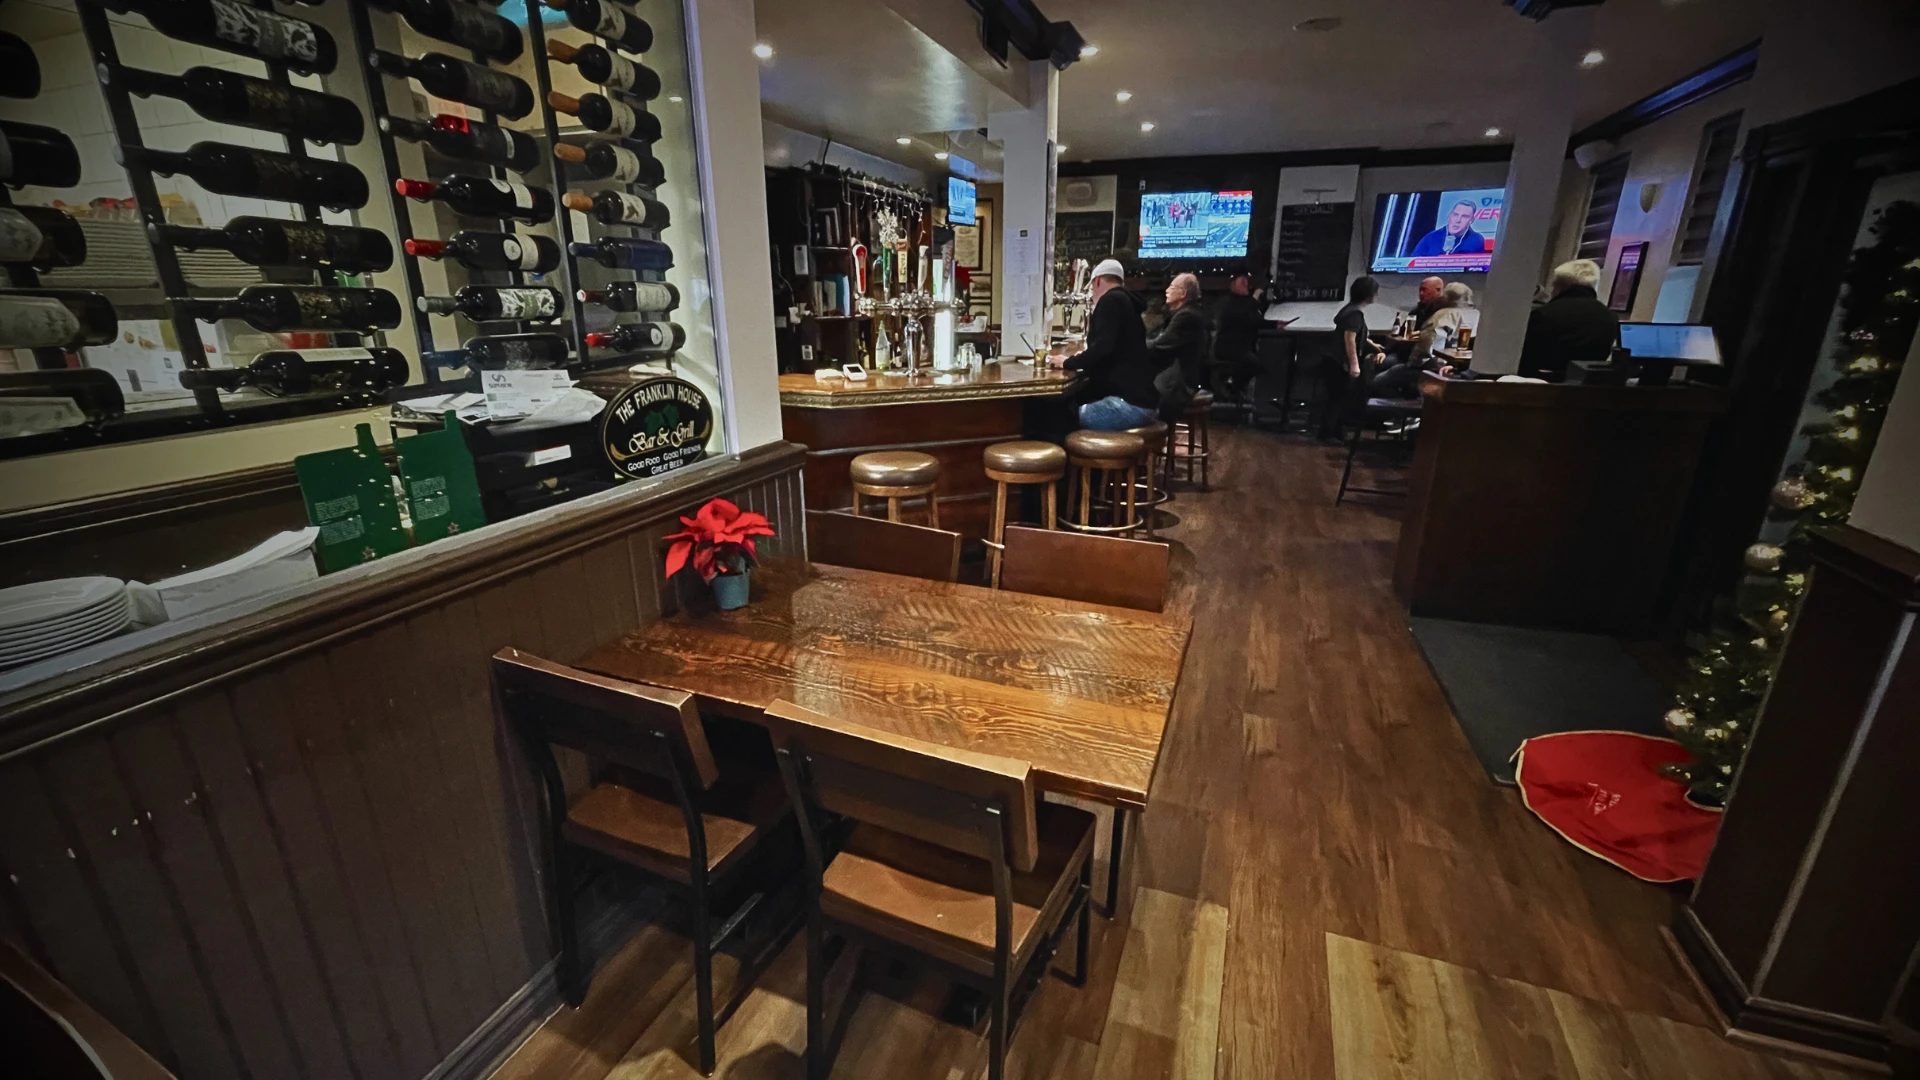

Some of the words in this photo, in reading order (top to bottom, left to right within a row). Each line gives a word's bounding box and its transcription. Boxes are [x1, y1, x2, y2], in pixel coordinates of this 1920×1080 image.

[615, 398, 635, 424] THE
[634, 383, 675, 410] FRANKLIN
[677, 385, 702, 410] HOUSE
[628, 431, 656, 453] Bar
[656, 427, 670, 446] &
[670, 420, 695, 447] Grill
[627, 460, 645, 472] GOOD
[645, 456, 661, 467] FOOD
[663, 450, 679, 461] GOOD
[651, 464, 669, 475] GREAT
[669, 459, 684, 470] BEER
